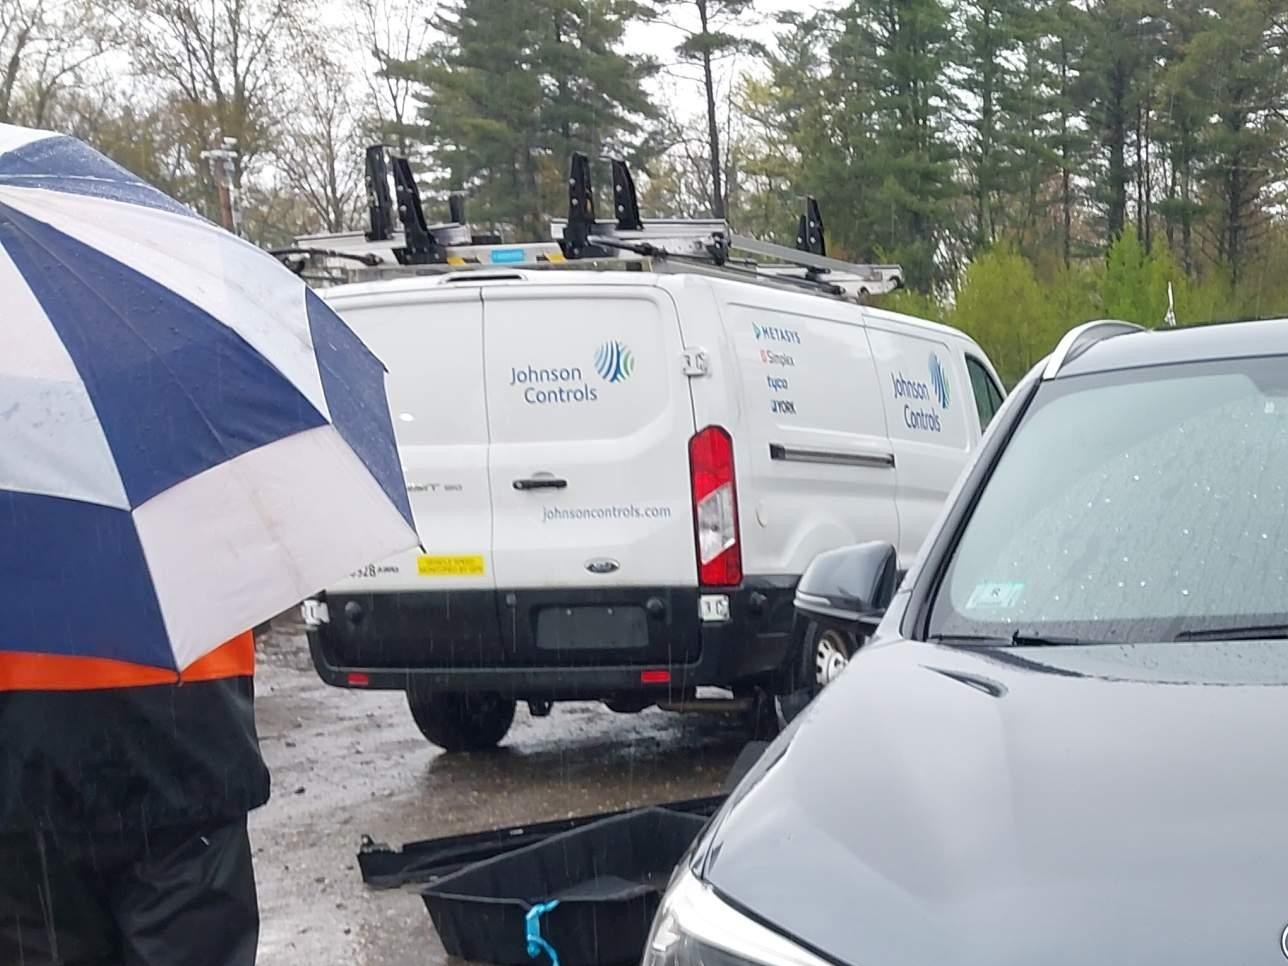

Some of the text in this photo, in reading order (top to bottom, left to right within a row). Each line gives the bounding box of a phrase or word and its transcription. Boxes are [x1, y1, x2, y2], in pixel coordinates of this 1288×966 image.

[510, 365, 582, 386] Johnson
[891, 370, 930, 400] Johnson
[524, 383, 598, 404] Controls
[904, 403, 941, 432] Controls
[542, 503, 672, 523] johnsoncontrols.com
